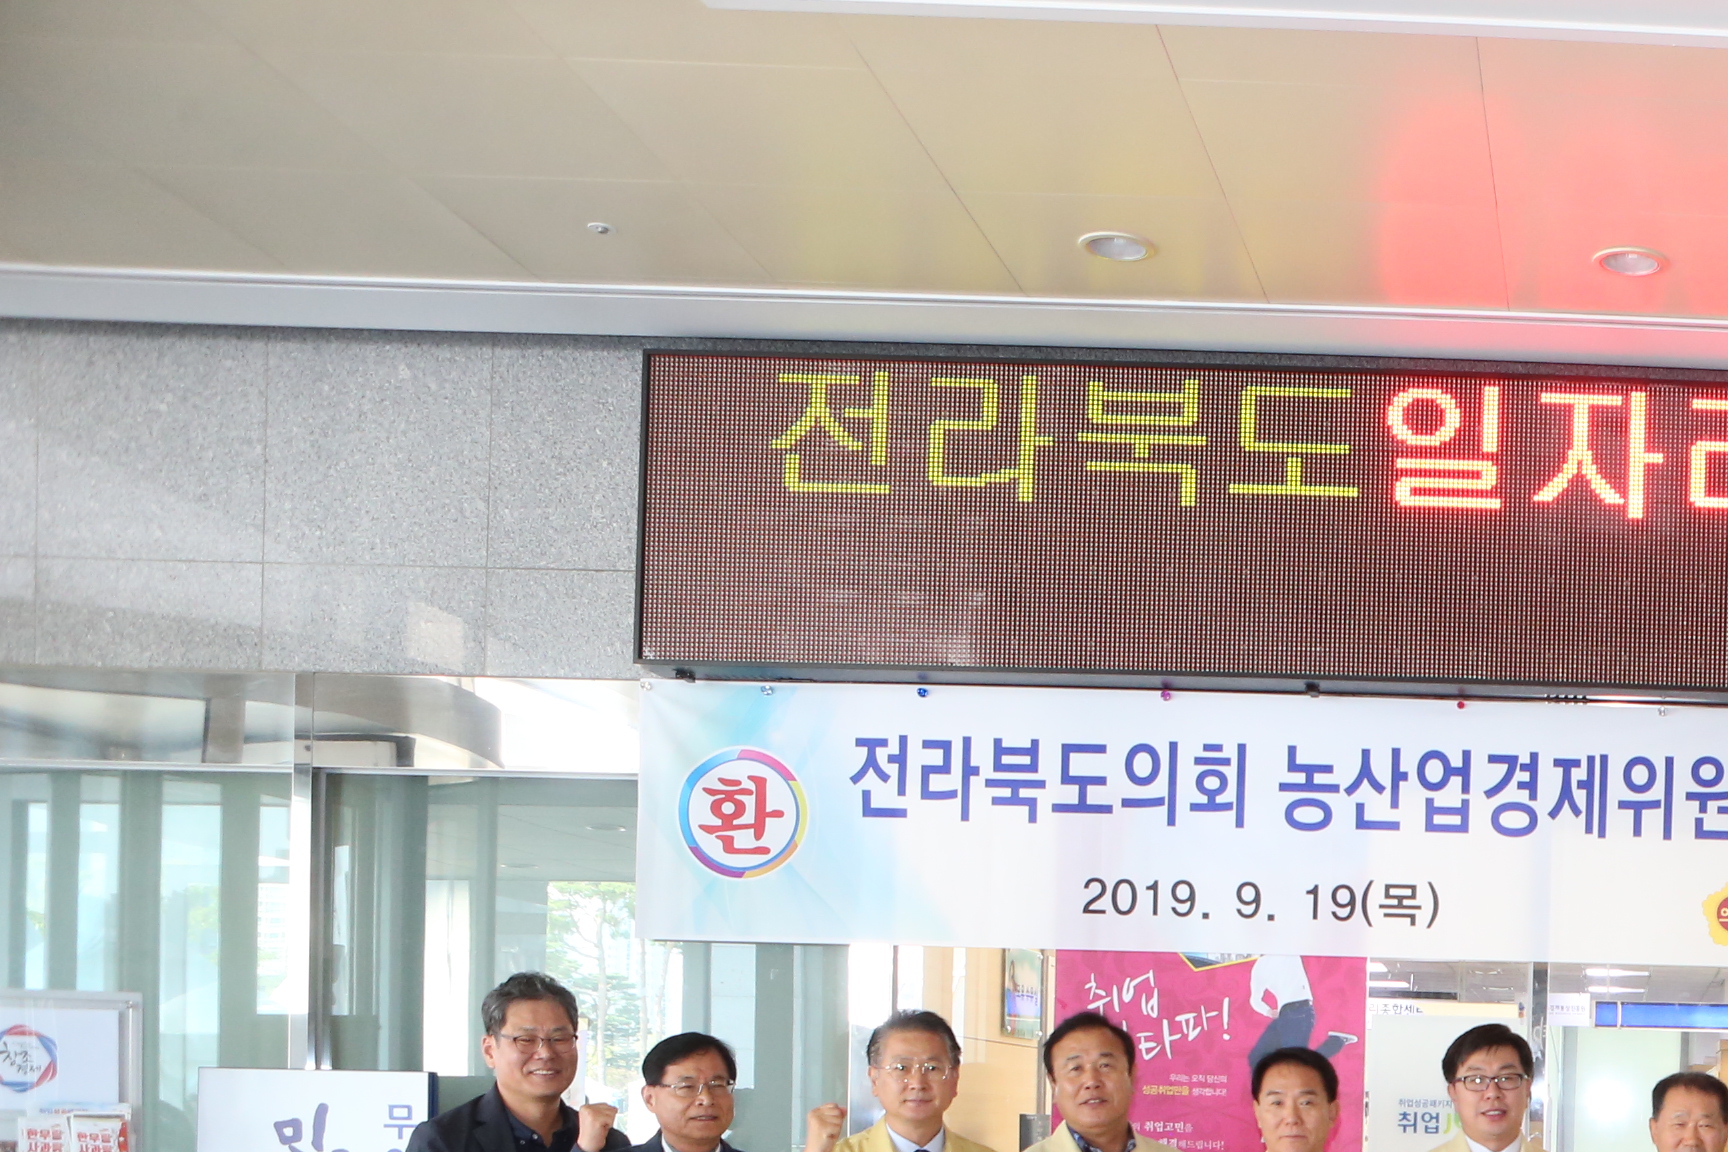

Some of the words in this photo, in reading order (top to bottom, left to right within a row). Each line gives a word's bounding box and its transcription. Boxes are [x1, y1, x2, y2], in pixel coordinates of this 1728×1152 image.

[849, 734, 1247, 828] 전라북도의회
[700, 776, 786, 856] 환
[1082, 878, 1209, 920] 2019.
[1236, 882, 1275, 921] 9.
[1306, 880, 1440, 929] 19(목)
[1084, 969, 1159, 1019] 취업
